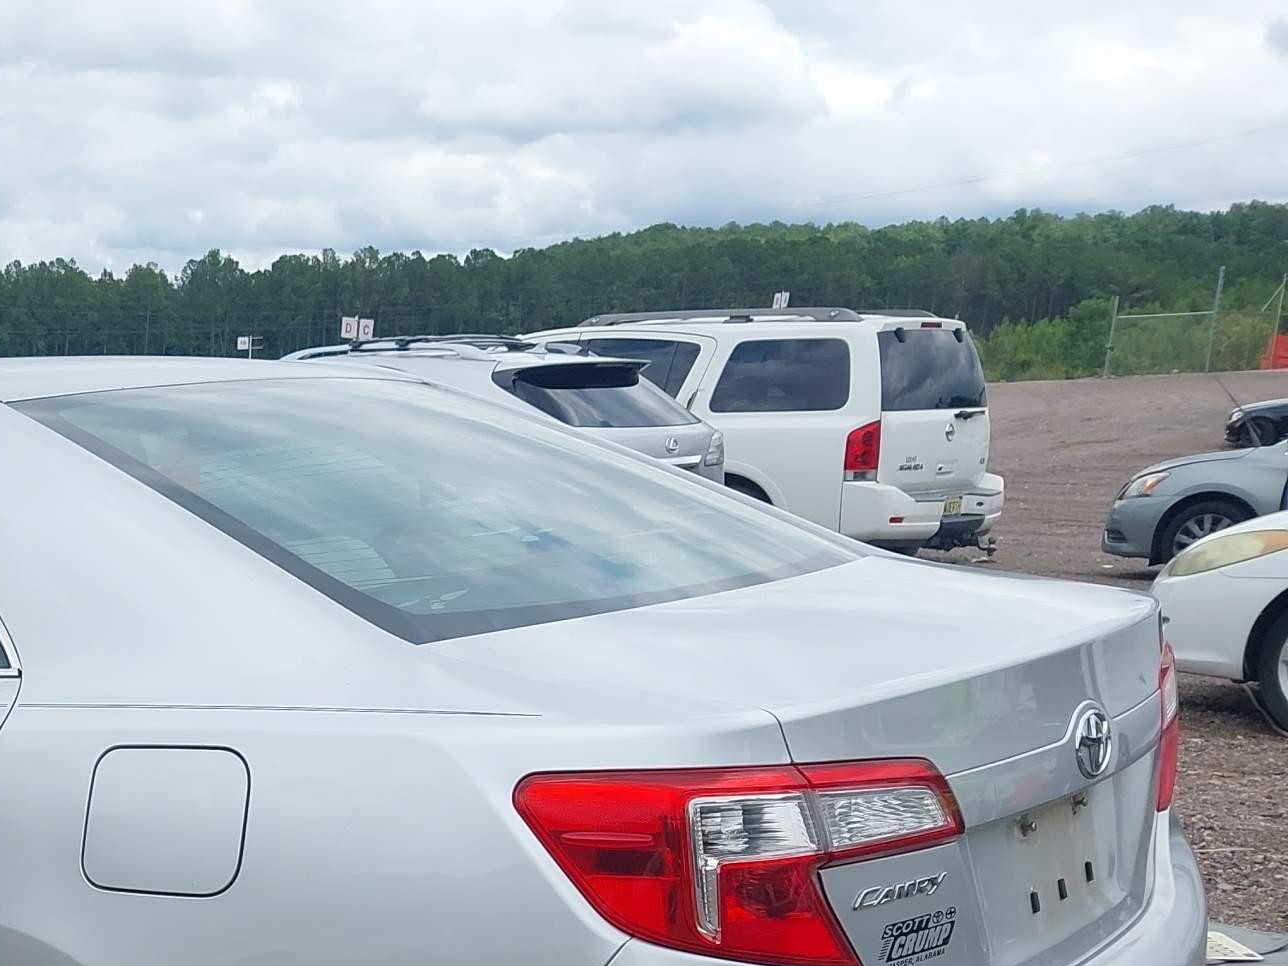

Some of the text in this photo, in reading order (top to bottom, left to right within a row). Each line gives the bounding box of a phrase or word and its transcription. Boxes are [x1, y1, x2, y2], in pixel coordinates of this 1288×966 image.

[345, 322, 352, 334] D
[363, 325, 370, 336] C
[852, 872, 948, 910] CAMRY
[883, 915, 930, 937] SCOTT
[891, 922, 951, 959] CRUMP
[915, 948, 946, 963] ALABAMA
